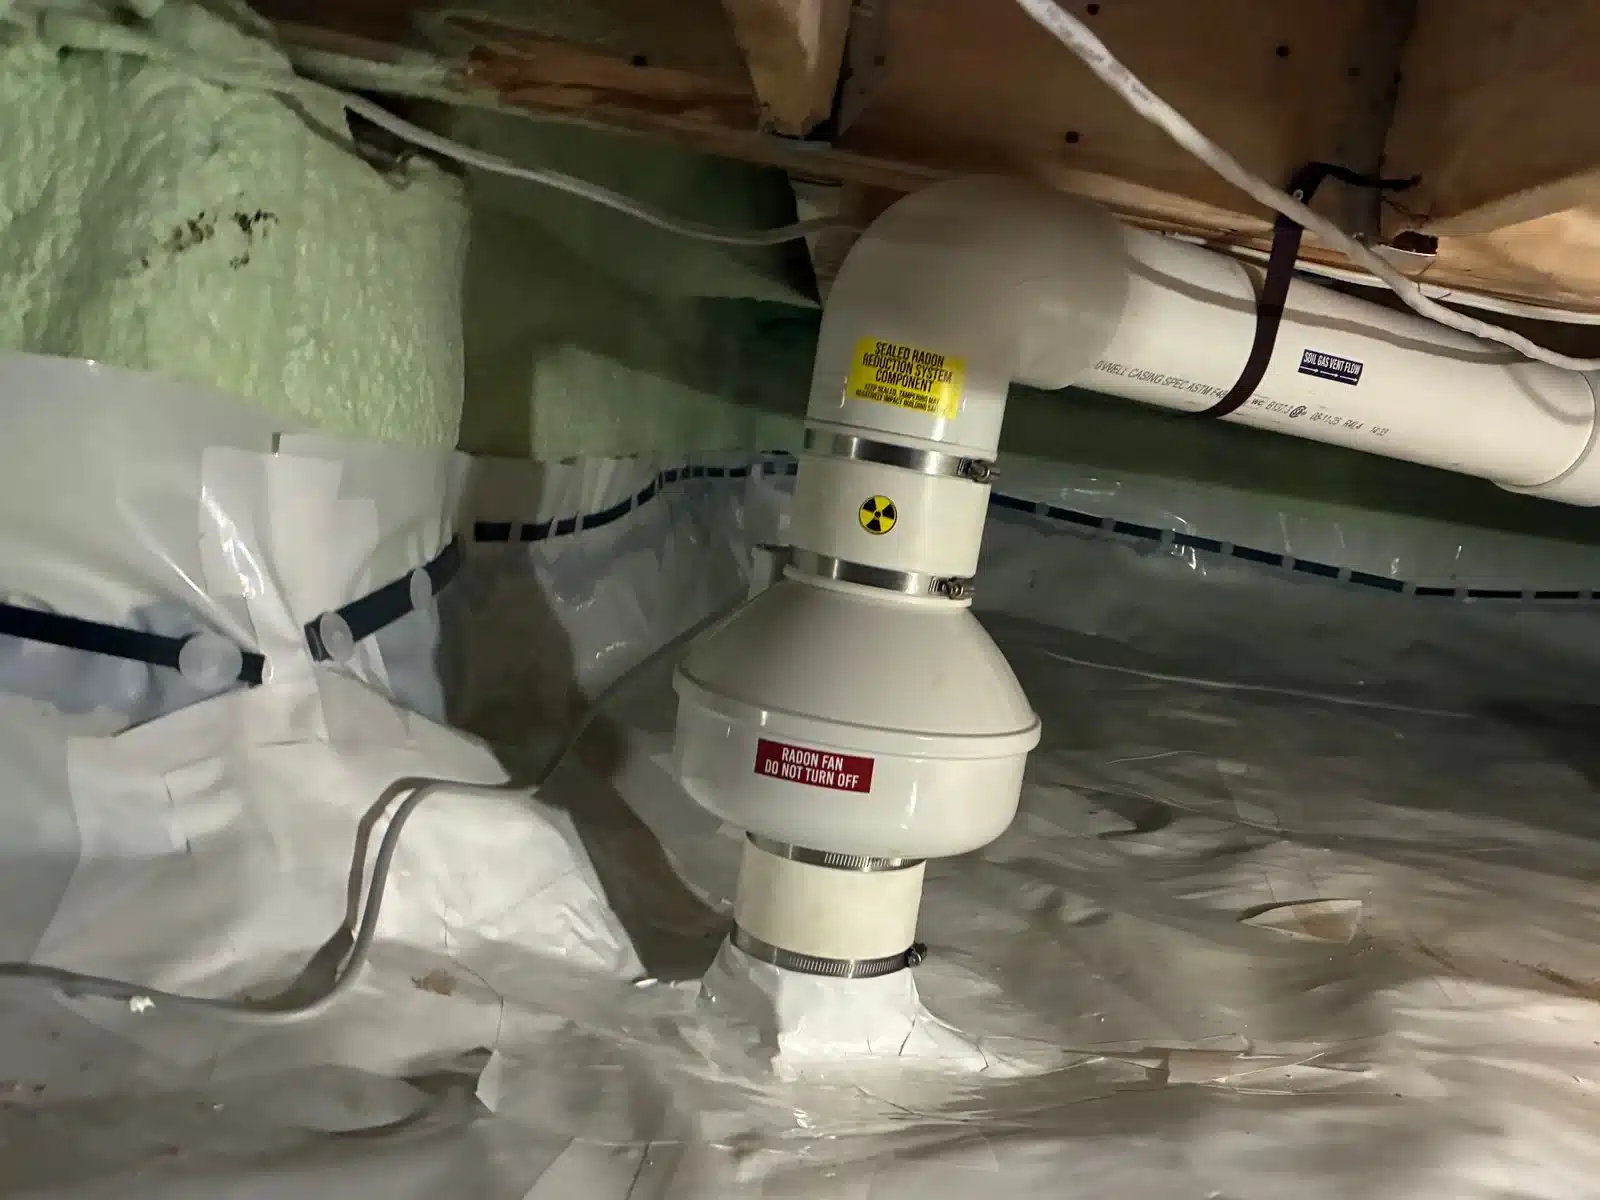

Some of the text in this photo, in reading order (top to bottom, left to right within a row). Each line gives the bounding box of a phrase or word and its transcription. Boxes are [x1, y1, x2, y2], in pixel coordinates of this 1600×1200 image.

[862, 352, 953, 383] REDUCTION SYSTEM
[875, 342, 945, 368] SEALED RADON
[1303, 352, 1361, 375] SOIL GAS VENT FLOW
[875, 368, 934, 392] COMPONENT
[1127, 368, 1164, 384] CASING
[1162, 376, 1190, 390] SPEC
[1187, 382, 1213, 396] ASTM
[781, 747, 844, 771] RADON FAN
[764, 758, 860, 789] DO NOT TURN OFF
